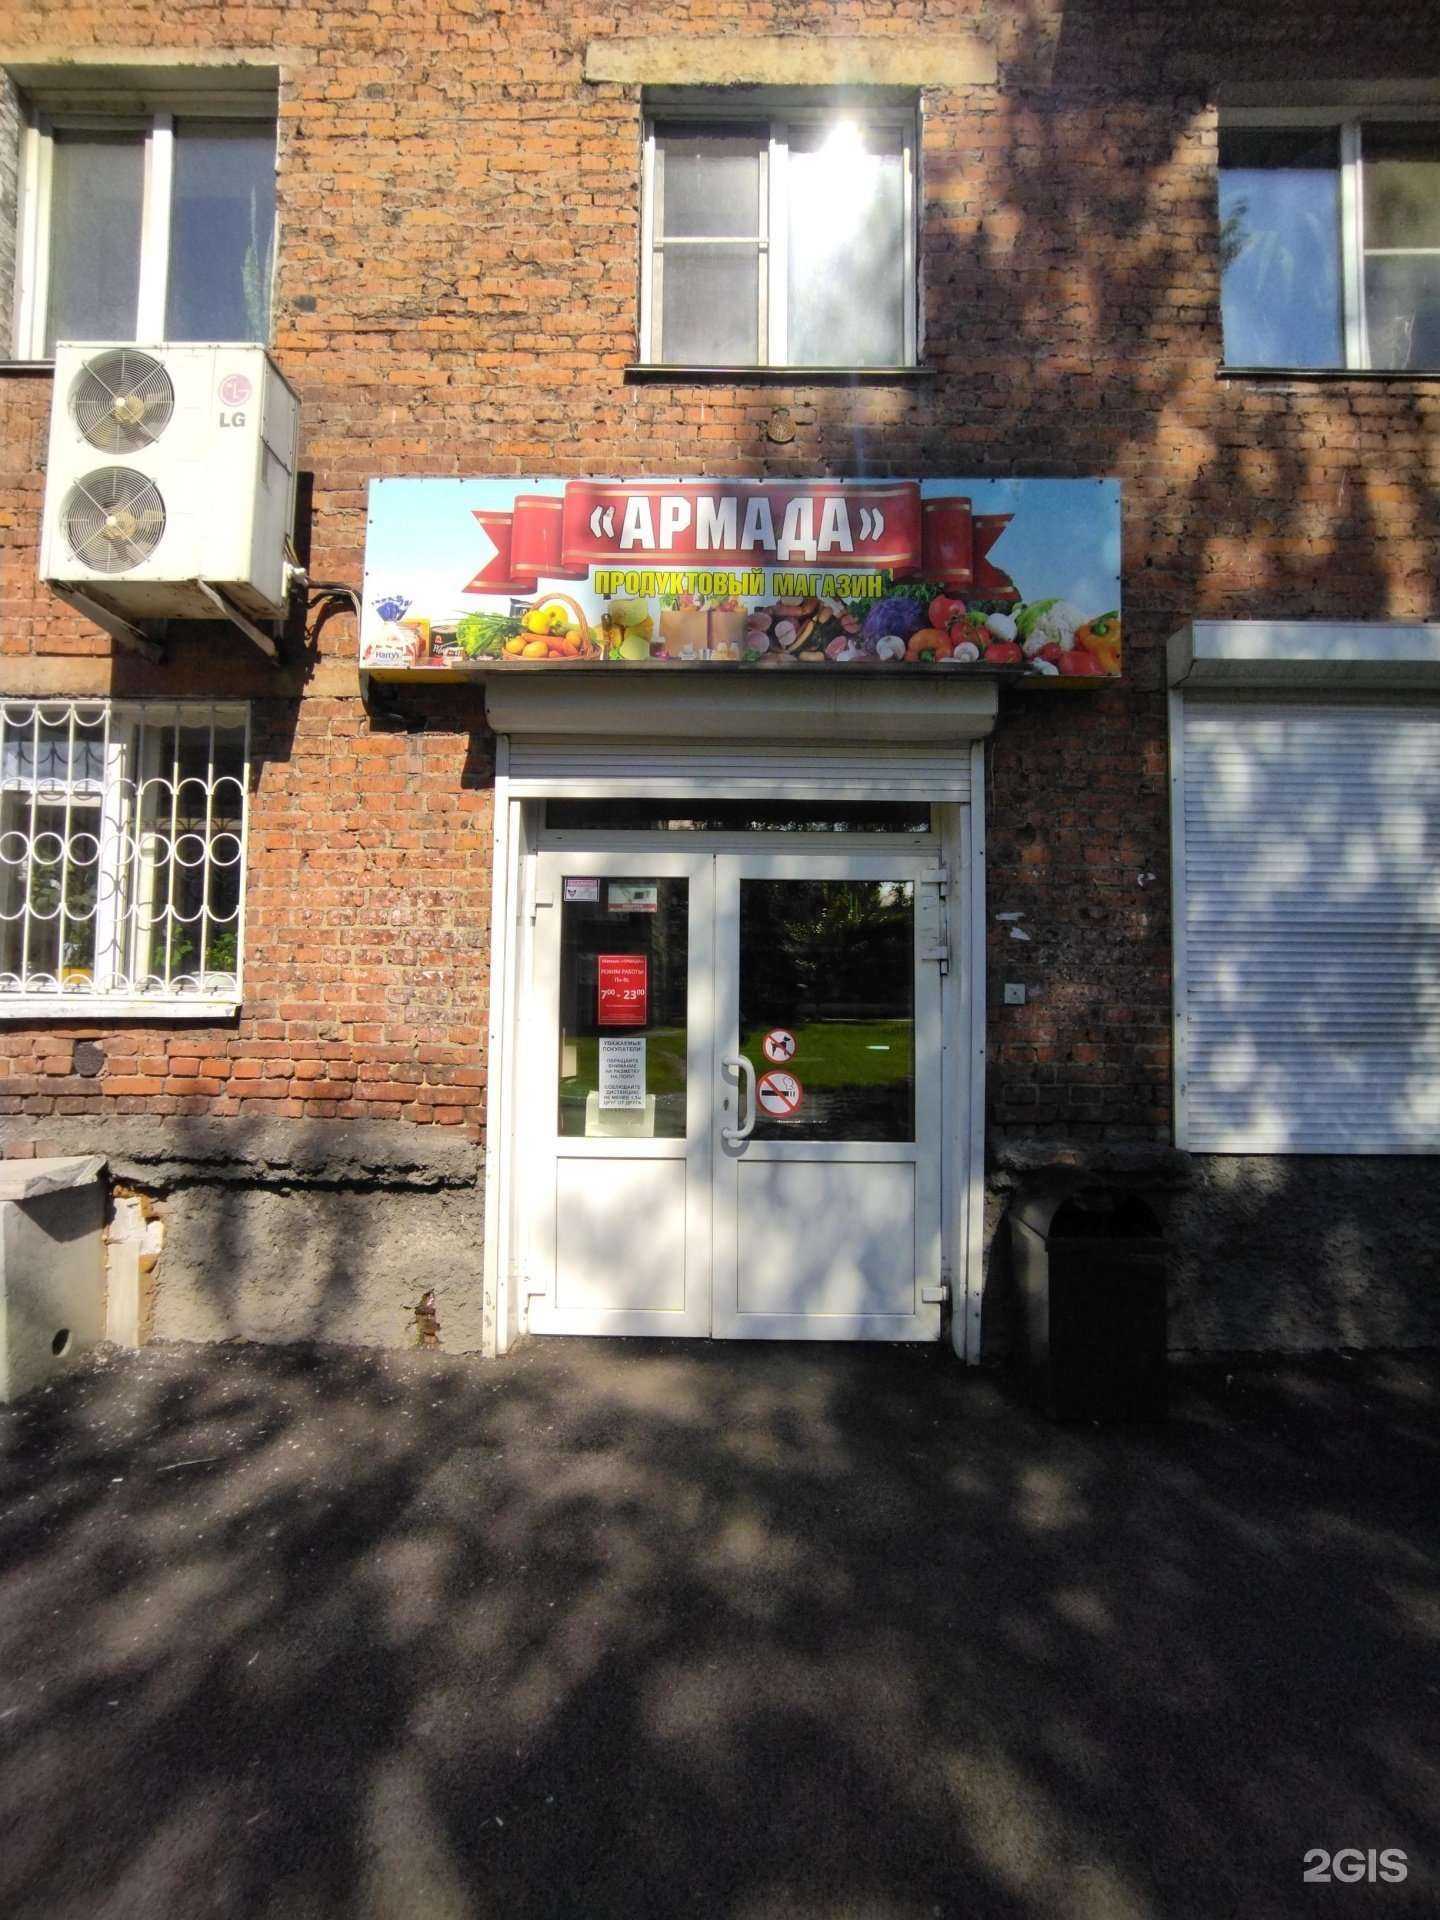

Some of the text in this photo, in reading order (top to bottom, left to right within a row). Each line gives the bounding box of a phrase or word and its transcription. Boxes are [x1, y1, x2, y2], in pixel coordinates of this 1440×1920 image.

[219, 411, 246, 428] LG
[589, 496, 885, 561] «АРМАДА»
[594, 567, 883, 599] ПРОДУКТОВЫЙ МАГАЗИН
